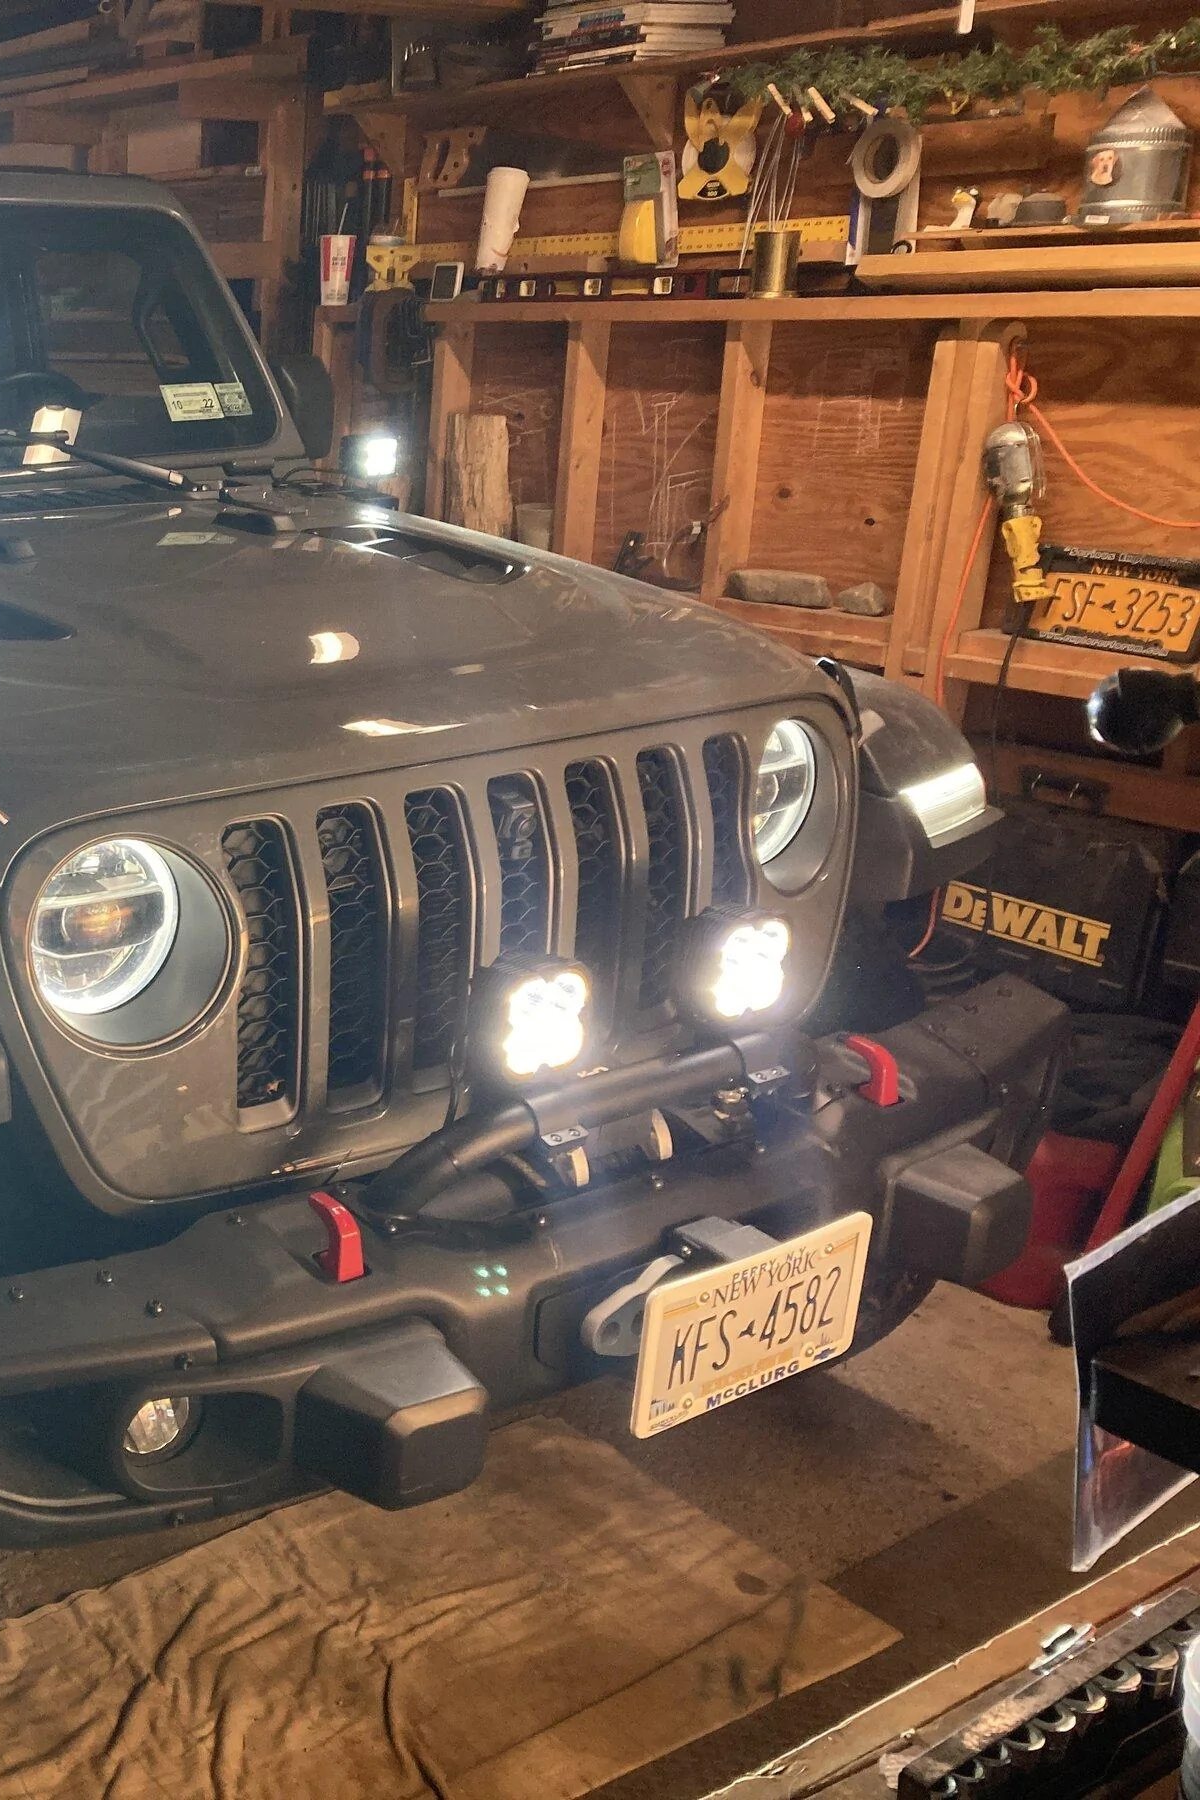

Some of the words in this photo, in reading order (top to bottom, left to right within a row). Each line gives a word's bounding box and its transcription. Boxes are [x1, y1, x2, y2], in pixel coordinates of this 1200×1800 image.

[171, 400, 184, 411] 10
[202, 398, 215, 408] 22
[1115, 587, 1197, 637] 3253
[711, 1269, 762, 1308] NEW
[767, 1249, 818, 1288] YORK
